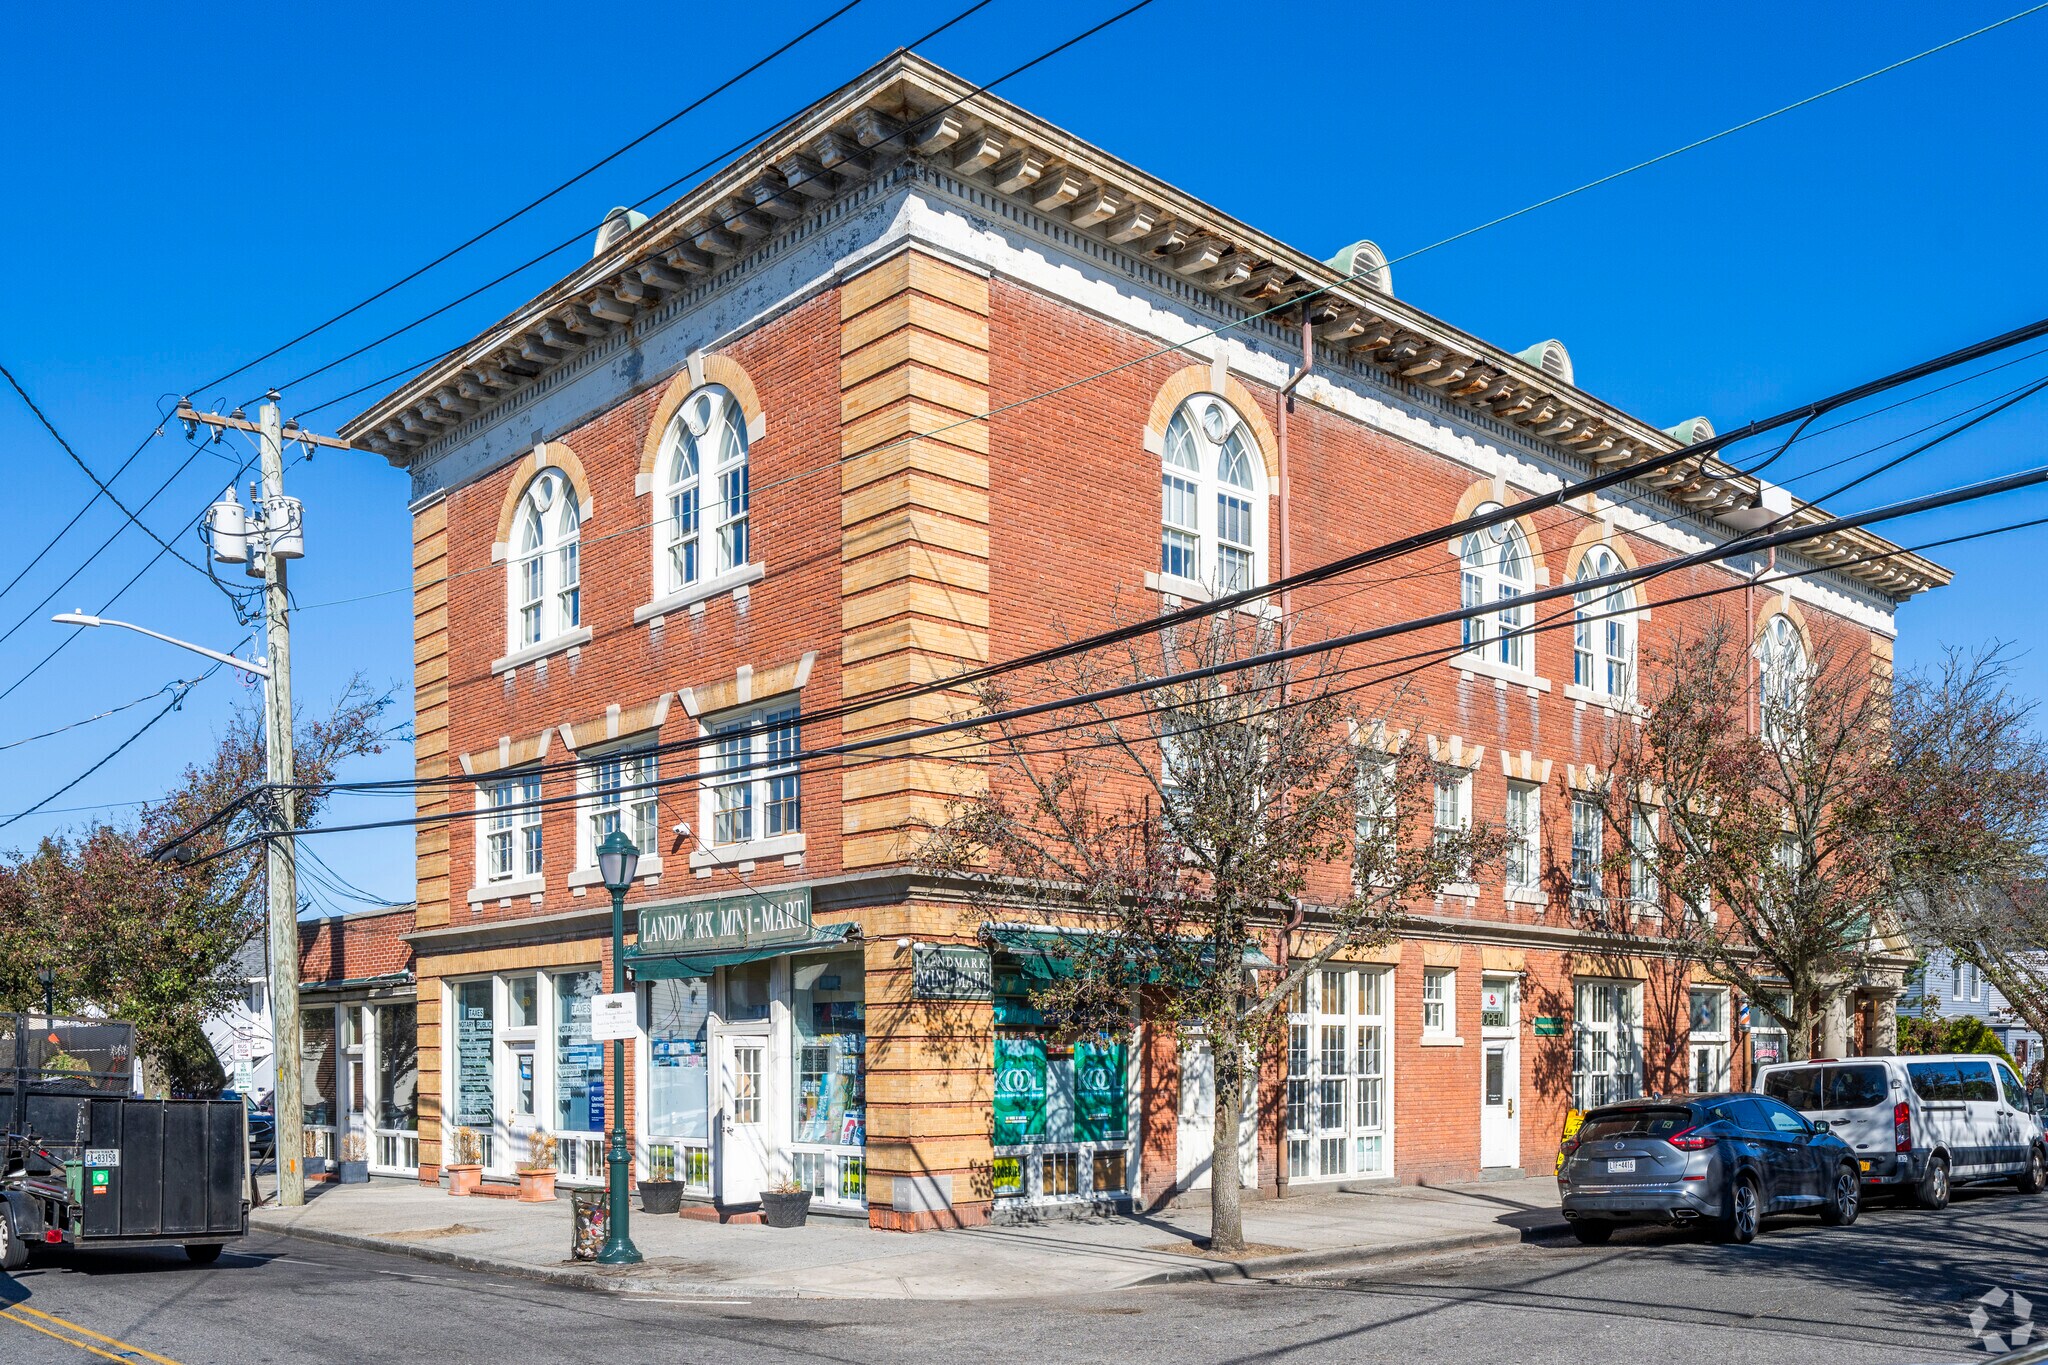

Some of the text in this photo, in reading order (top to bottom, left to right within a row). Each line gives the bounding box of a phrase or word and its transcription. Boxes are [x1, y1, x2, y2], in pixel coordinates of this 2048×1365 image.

[643, 900, 805, 943] LANDMRK MINI-MART
[923, 956, 986, 969] LANDMARK
[919, 969, 989, 989] MINI-MART
[469, 1009, 484, 1017] TAXES
[572, 1004, 591, 1013] TAXES
[459, 1021, 492, 1029] NOTARY PUBLIC
[1482, 1013, 1504, 1026] OPEN
[995, 1069, 1043, 1092] KOOL
[1078, 1069, 1124, 1090] KOOL
